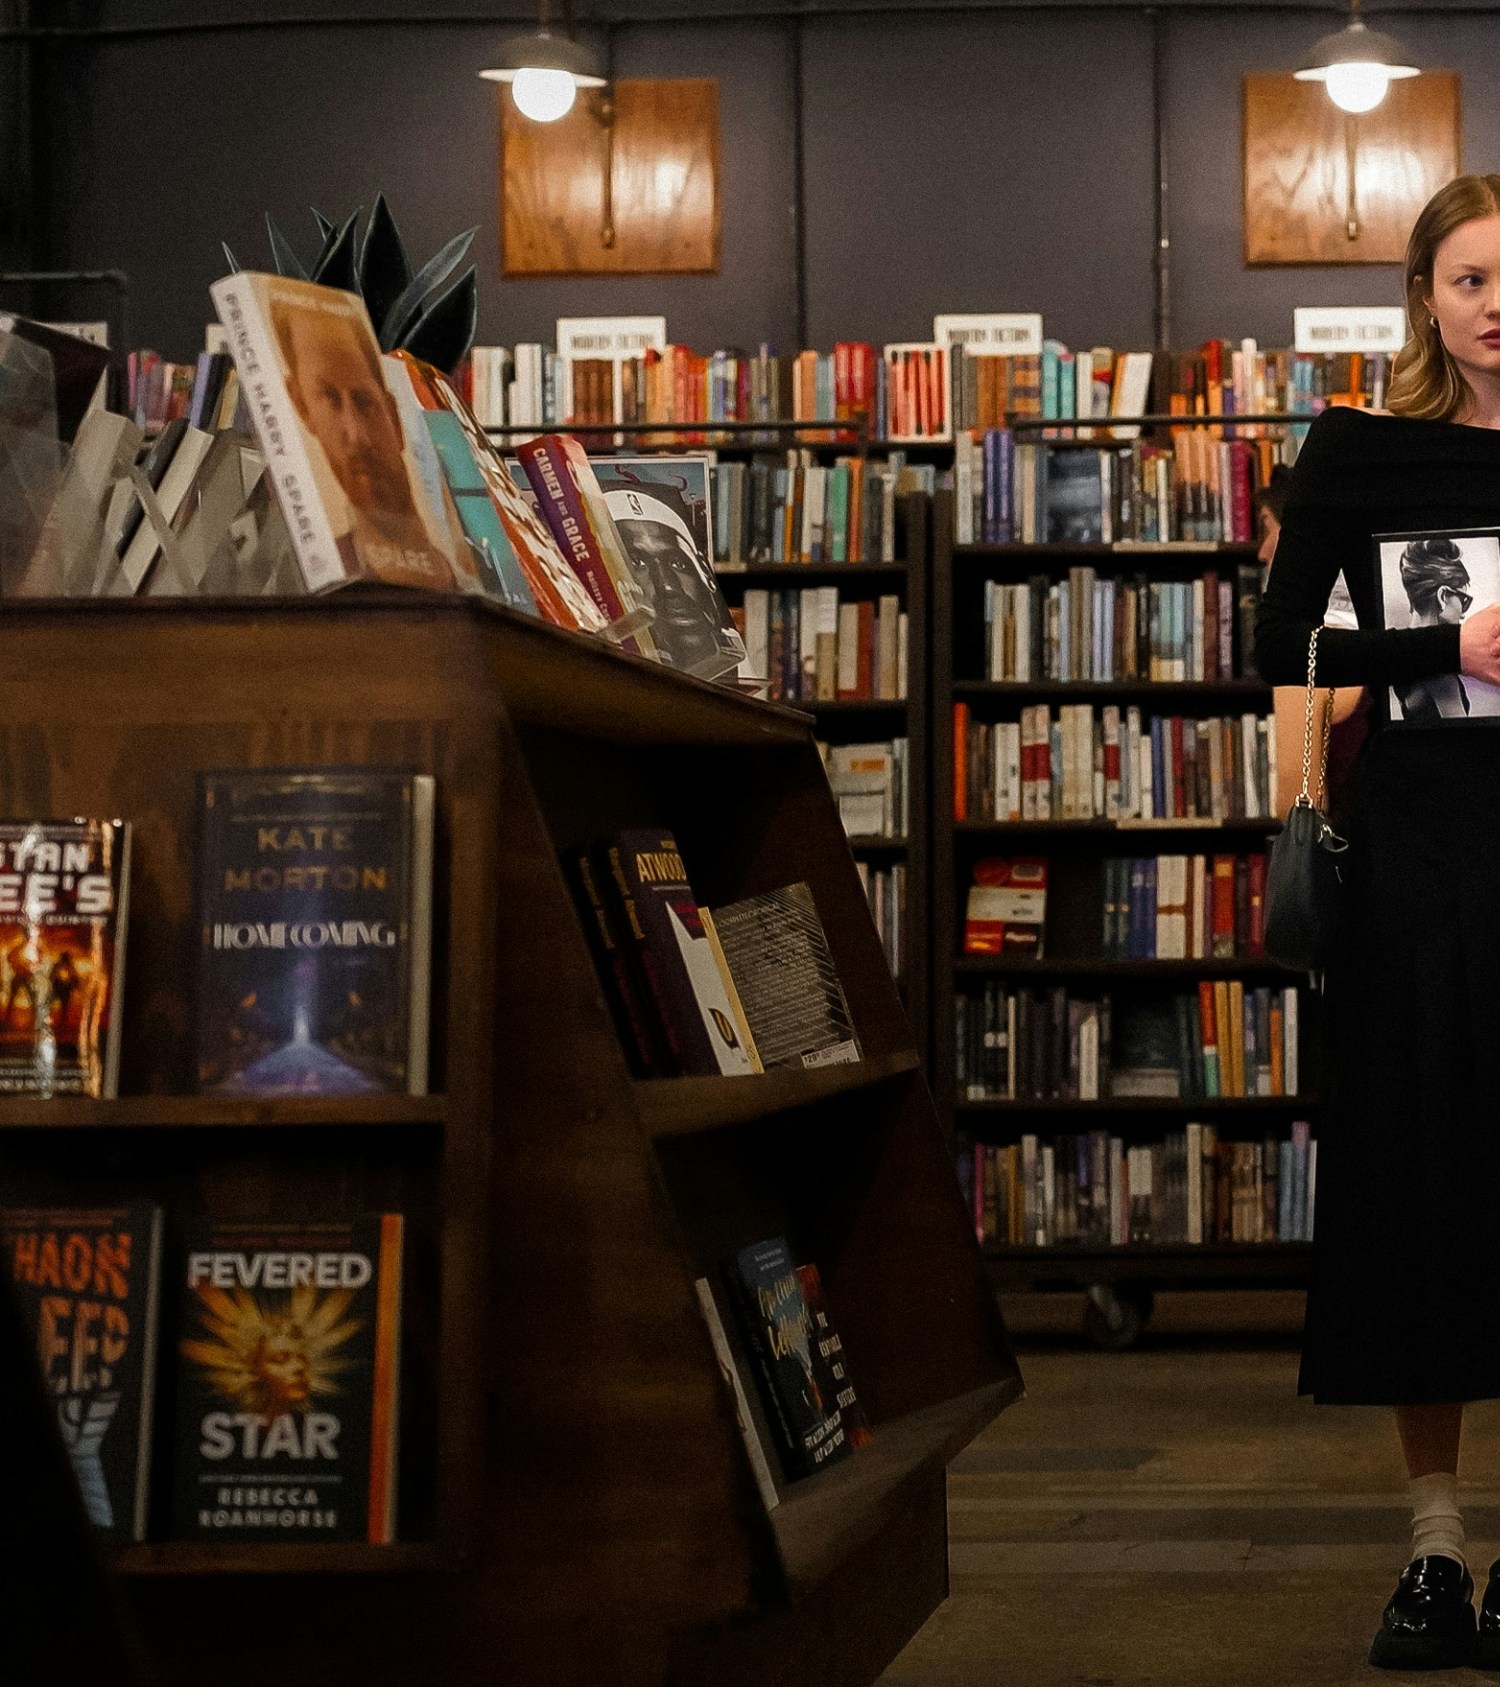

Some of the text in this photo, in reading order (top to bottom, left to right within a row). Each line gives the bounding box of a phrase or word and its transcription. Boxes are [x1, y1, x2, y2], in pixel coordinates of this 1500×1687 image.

[225, 291, 316, 545] PRINCE HARRY SPARE
[533, 447, 565, 500] CARMEN
[561, 517, 590, 563] GRACE
[0, 841, 90, 872] TAN
[257, 826, 354, 852] KATE
[0, 873, 112, 914] EE'S
[224, 865, 389, 892] MORTON
[213, 920, 396, 950] HOMECOMING
[11, 1232, 133, 1300] HAON
[187, 1252, 372, 1289] FEVERED
[39, 1297, 130, 1394] EEP
[200, 1411, 342, 1461] STAR
[216, 1488, 319, 1507] REBECCA
